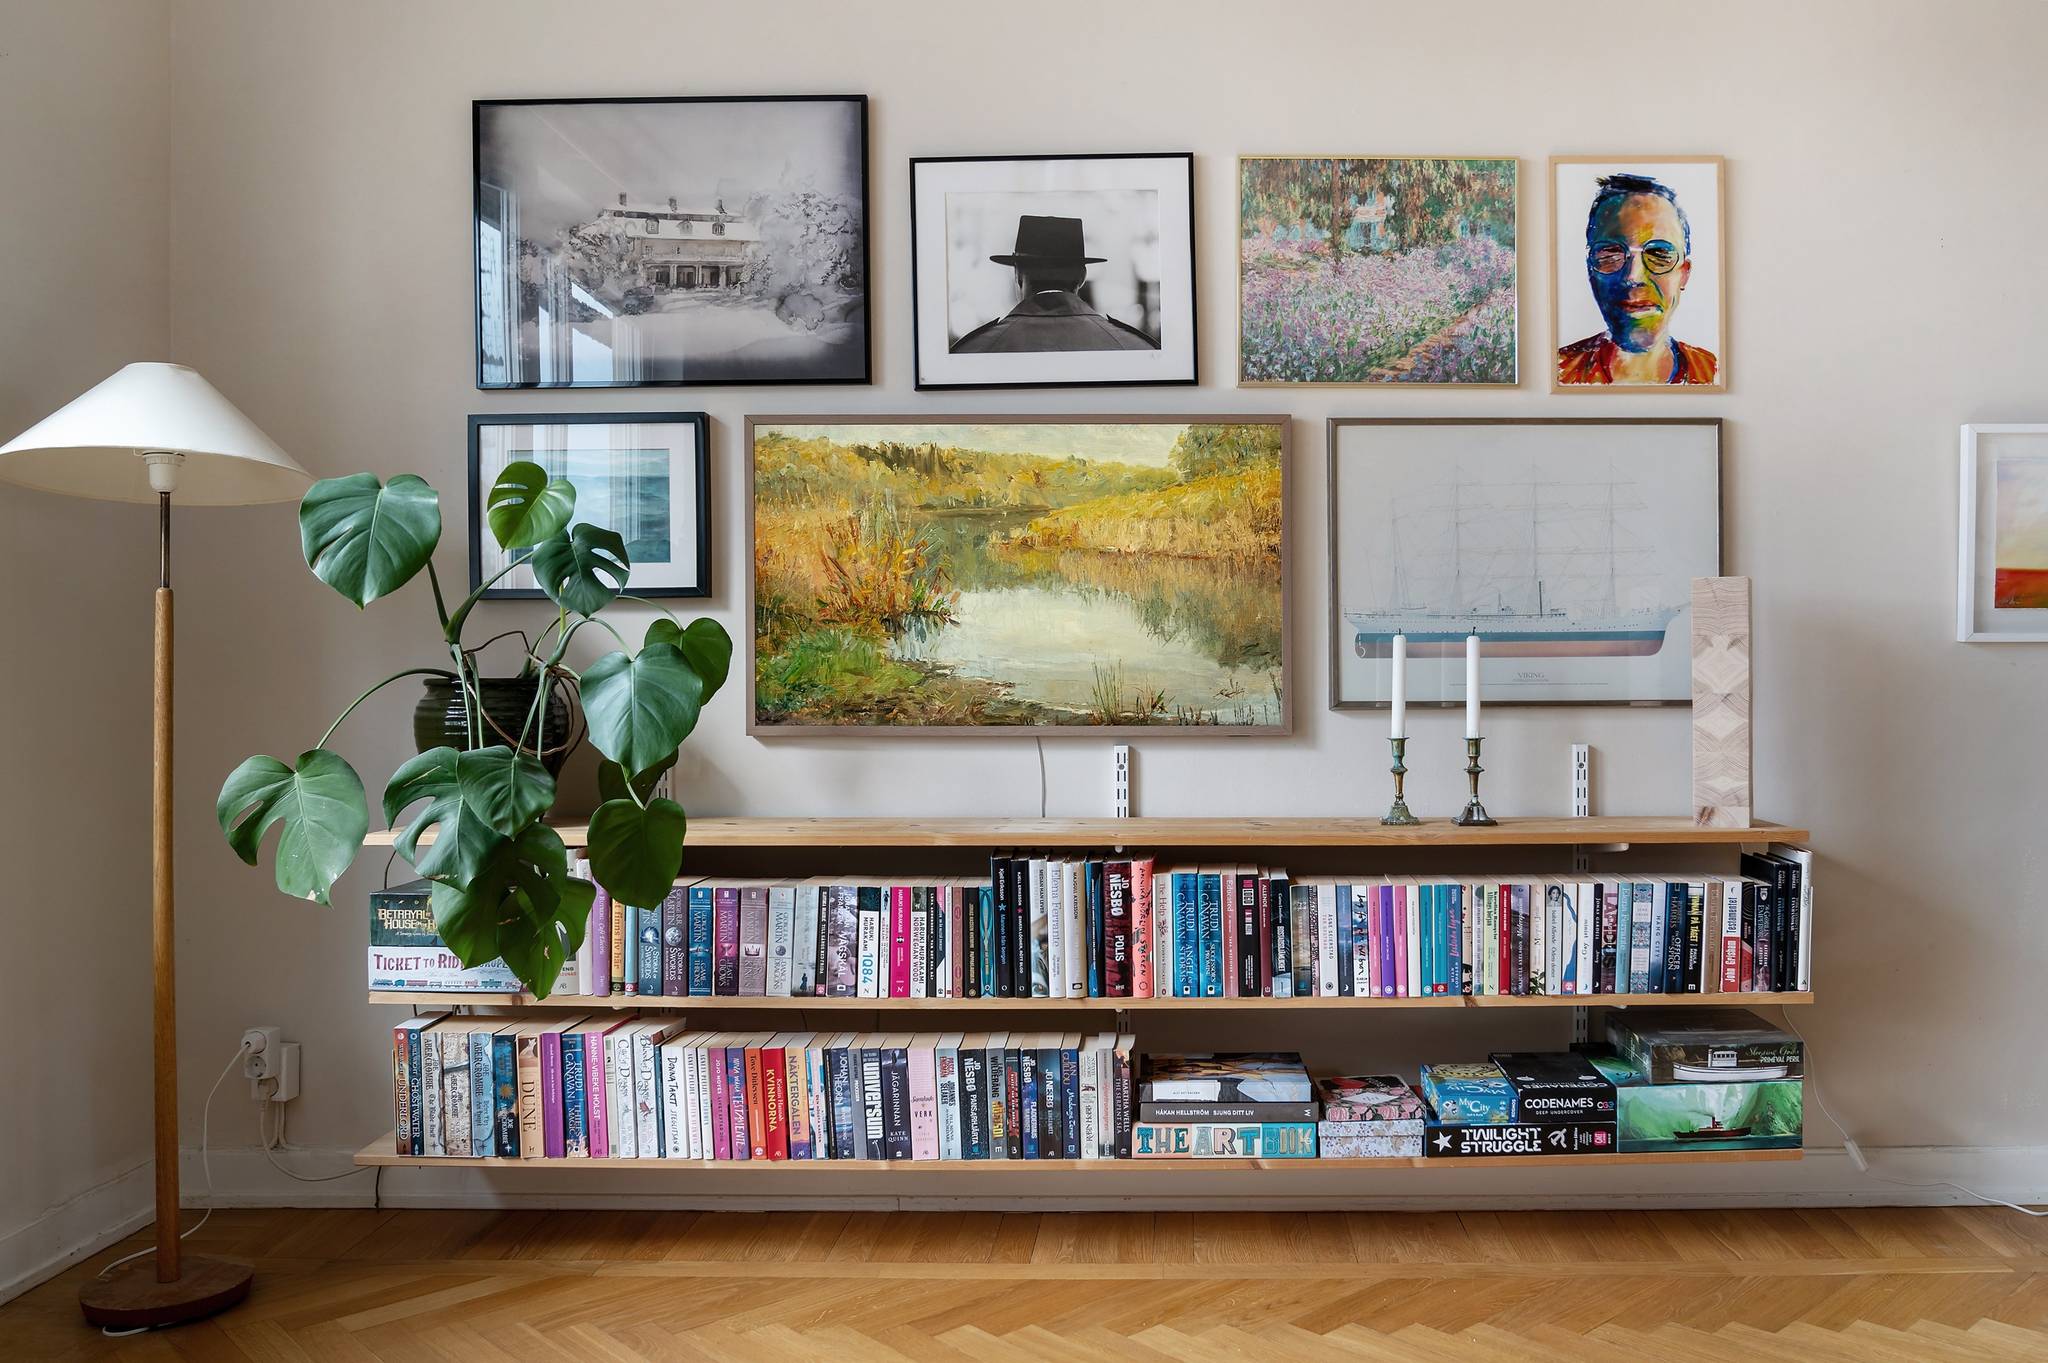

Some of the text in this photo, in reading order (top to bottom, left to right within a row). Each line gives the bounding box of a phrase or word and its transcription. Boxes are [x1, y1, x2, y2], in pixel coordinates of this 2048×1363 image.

[1051, 869, 1061, 899] Elena
[1109, 874, 1124, 916] NESBØ
[1121, 878, 1129, 889] JO
[378, 909, 428, 920] BETRAYAL
[1158, 897, 1167, 916] Help
[1176, 893, 1187, 939] CANAVAN
[1186, 900, 1194, 931] TRUDI
[1199, 893, 1211, 939] CANAVAN
[1210, 900, 1218, 931] TRUDI
[1670, 896, 1678, 928] HARRIS
[384, 919, 416, 929] HOUSE
[613, 912, 621, 935] finns
[720, 911, 728, 942] MARTIN
[1051, 902, 1062, 947] Ferrante
[1726, 897, 1737, 982] John Grisham Testamentet
[374, 954, 422, 970] TICKET
[423, 958, 435, 968] TO
[438, 953, 464, 969] RID
[644, 946, 652, 979] SWORDS
[669, 947, 677, 980] SWORDS
[1114, 935, 1124, 961] POLIS
[1185, 943, 1194, 976] ANGEL
[1673, 937, 1681, 970] OFFICER
[862, 953, 873, 983] 1Q84
[424, 1038, 433, 1090] ABERCROMBIE
[474, 1042, 483, 1097] ABERCROMBIE
[564, 1053, 578, 1098] CANAVAN
[575, 1061, 583, 1091] TRUDI
[590, 1036, 601, 1119] HANNE-VIBEKE HOLST
[667, 1057, 677, 1082] DONNA
[839, 1055, 848, 1083] JOHAN
[964, 1058, 976, 1092] NESBØ
[974, 1060, 980, 1070] JO
[990, 1056, 1000, 1098] WILDERÄNG
[1023, 1056, 1032, 1083] NESBØ
[751, 1072, 759, 1104] Ditlevsen
[766, 1069, 777, 1132] KVINNORNA
[788, 1056, 800, 1135] NÄKTERGALEN
[834, 1073, 843, 1105] THEORIN
[863, 1061, 883, 1139] universum
[891, 1071, 900, 1126] JÄGARINNAN
[947, 1081, 956, 1107] JOHANNES
[1045, 1069, 1054, 1108] JO NESBØ
[1525, 1097, 1594, 1109] CODENAMES
[398, 1078, 409, 1140] UNDERLORD
[411, 1077, 420, 1138] GHOSTWATER
[522, 1081, 536, 1132] DUNE
[970, 1094, 979, 1145] PANSARHJÄRTA
[1470, 1100, 1490, 1114] City
[1137, 1127, 1189, 1154] THE
[1192, 1126, 1260, 1155] ART
[1461, 1128, 1542, 1140] TWILIGHT
[1461, 1140, 1542, 1153] STRUGGLE
